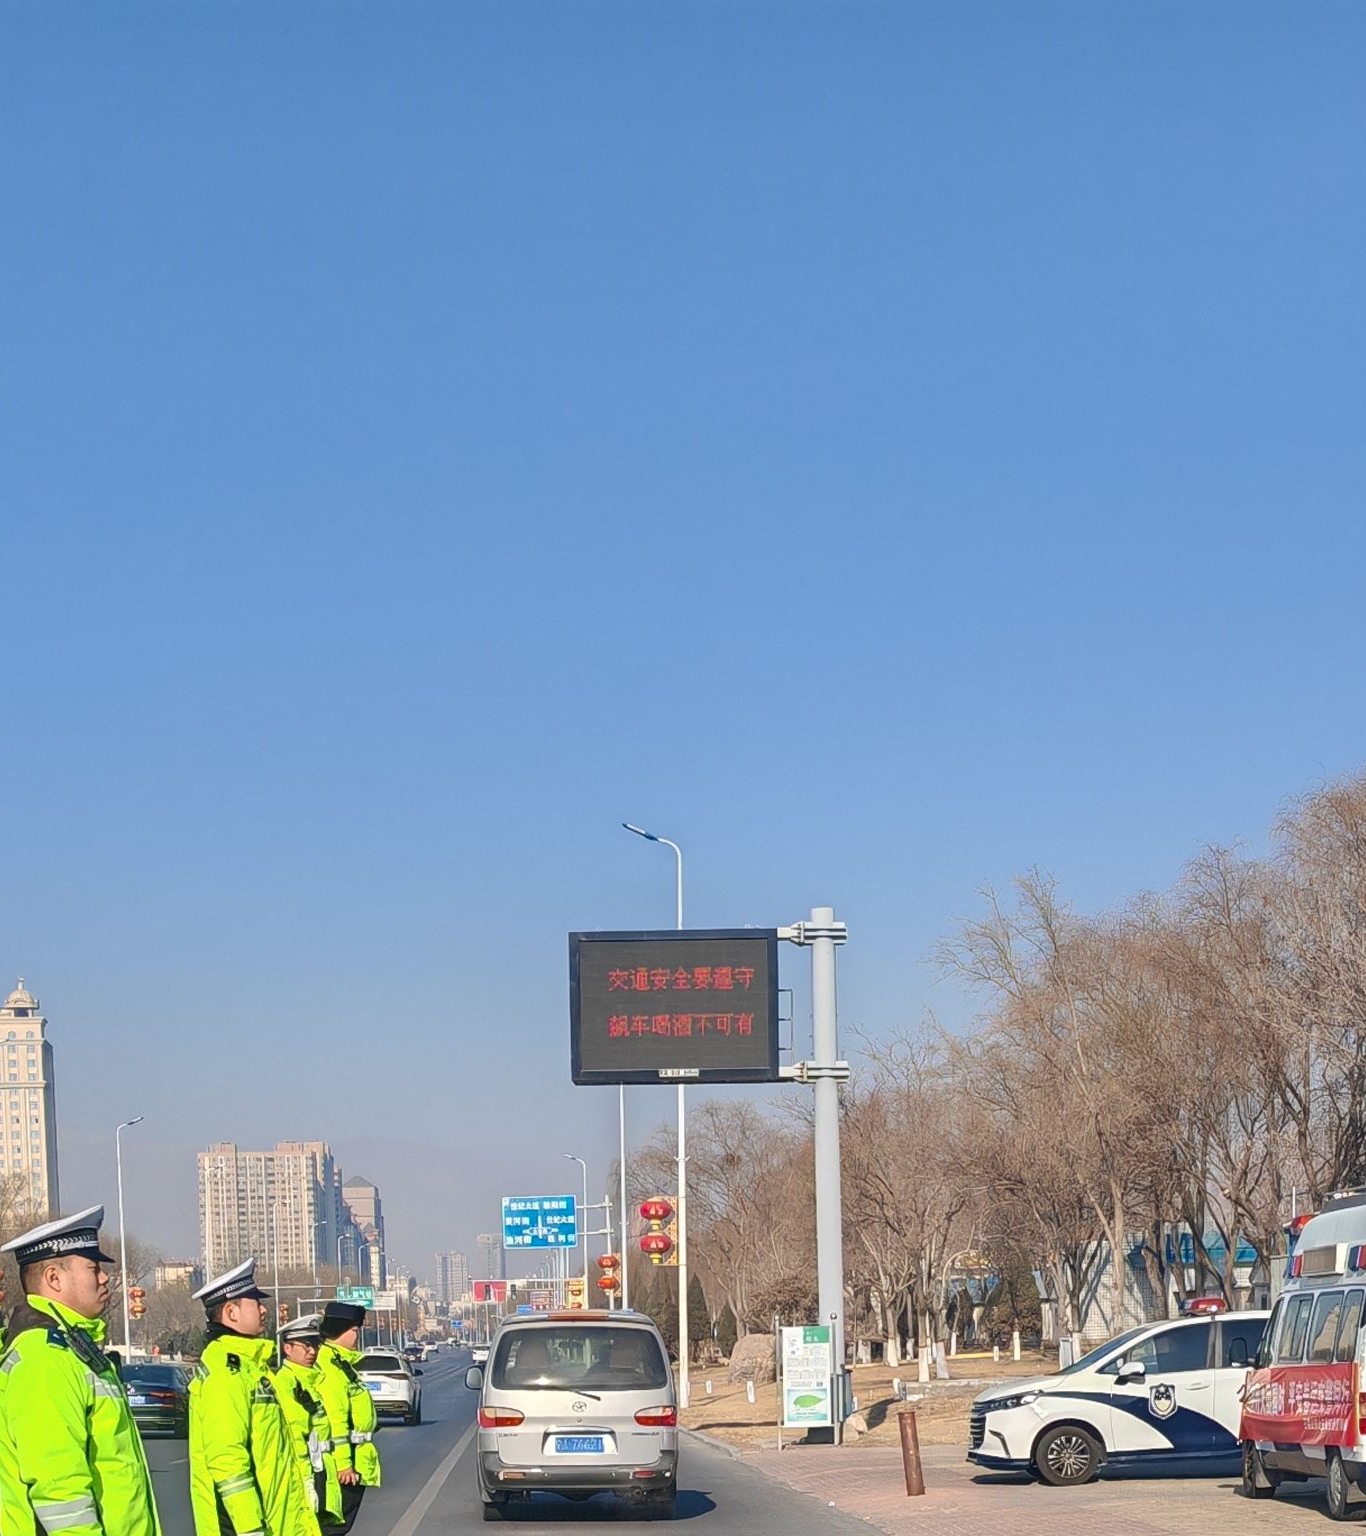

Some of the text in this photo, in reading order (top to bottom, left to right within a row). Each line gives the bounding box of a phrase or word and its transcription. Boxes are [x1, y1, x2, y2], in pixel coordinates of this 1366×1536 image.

[607, 966, 755, 991] 交通安全要遵守
